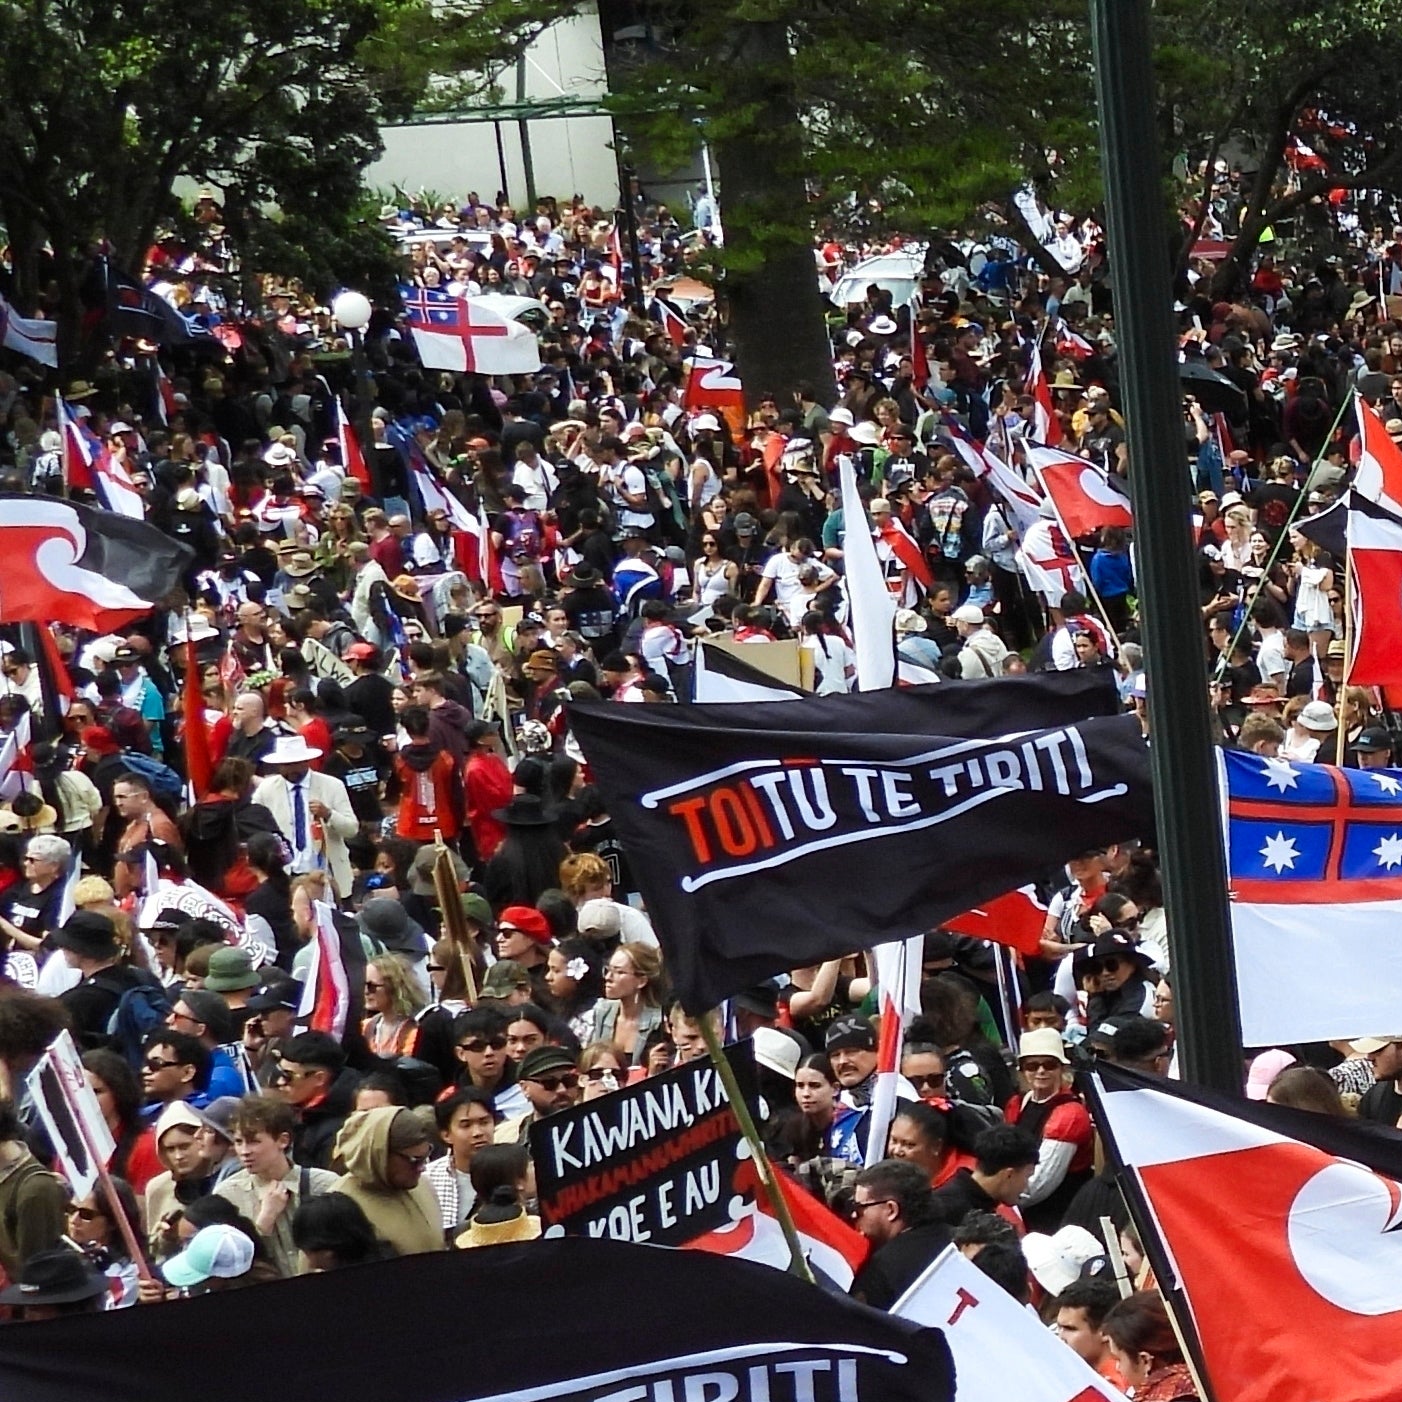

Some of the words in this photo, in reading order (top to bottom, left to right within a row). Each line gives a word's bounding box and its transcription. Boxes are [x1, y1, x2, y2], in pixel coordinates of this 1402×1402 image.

[842, 767, 921, 823] TE
[551, 1081, 695, 1179] KAWANA,
[658, 1179, 677, 1229] E
[685, 1159, 720, 1216] AU
